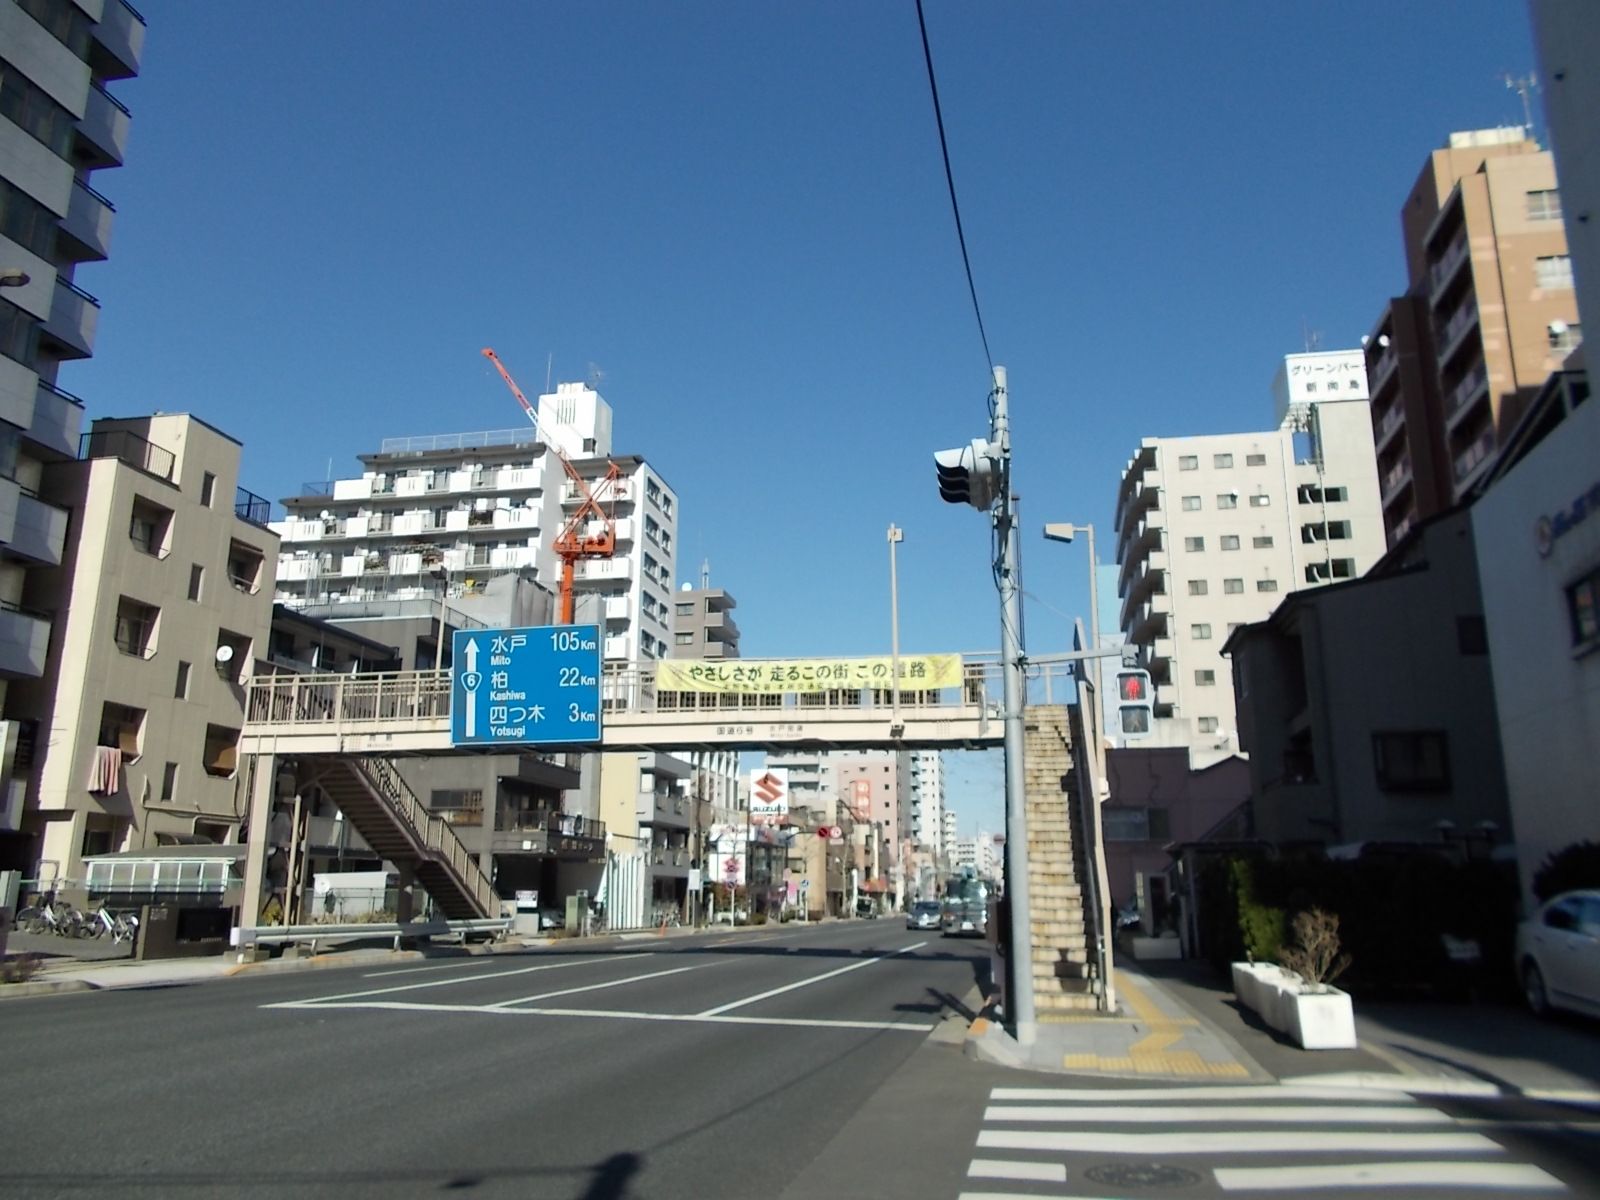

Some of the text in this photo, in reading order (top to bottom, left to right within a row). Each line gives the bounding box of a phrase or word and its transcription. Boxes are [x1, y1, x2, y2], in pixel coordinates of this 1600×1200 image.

[1292, 362, 1366, 375] グリーンパー
[490, 635, 527, 654] 水戸
[490, 656, 511, 666] Mito
[689, 665, 762, 681] やさしさが
[770, 663, 848, 682] 走るこの街
[467, 675, 476, 687] 6
[491, 670, 508, 689] 柏
[490, 690, 526, 701] Kashiwa
[490, 704, 546, 724] 四つ木
[490, 726, 526, 738] Yotsugi
